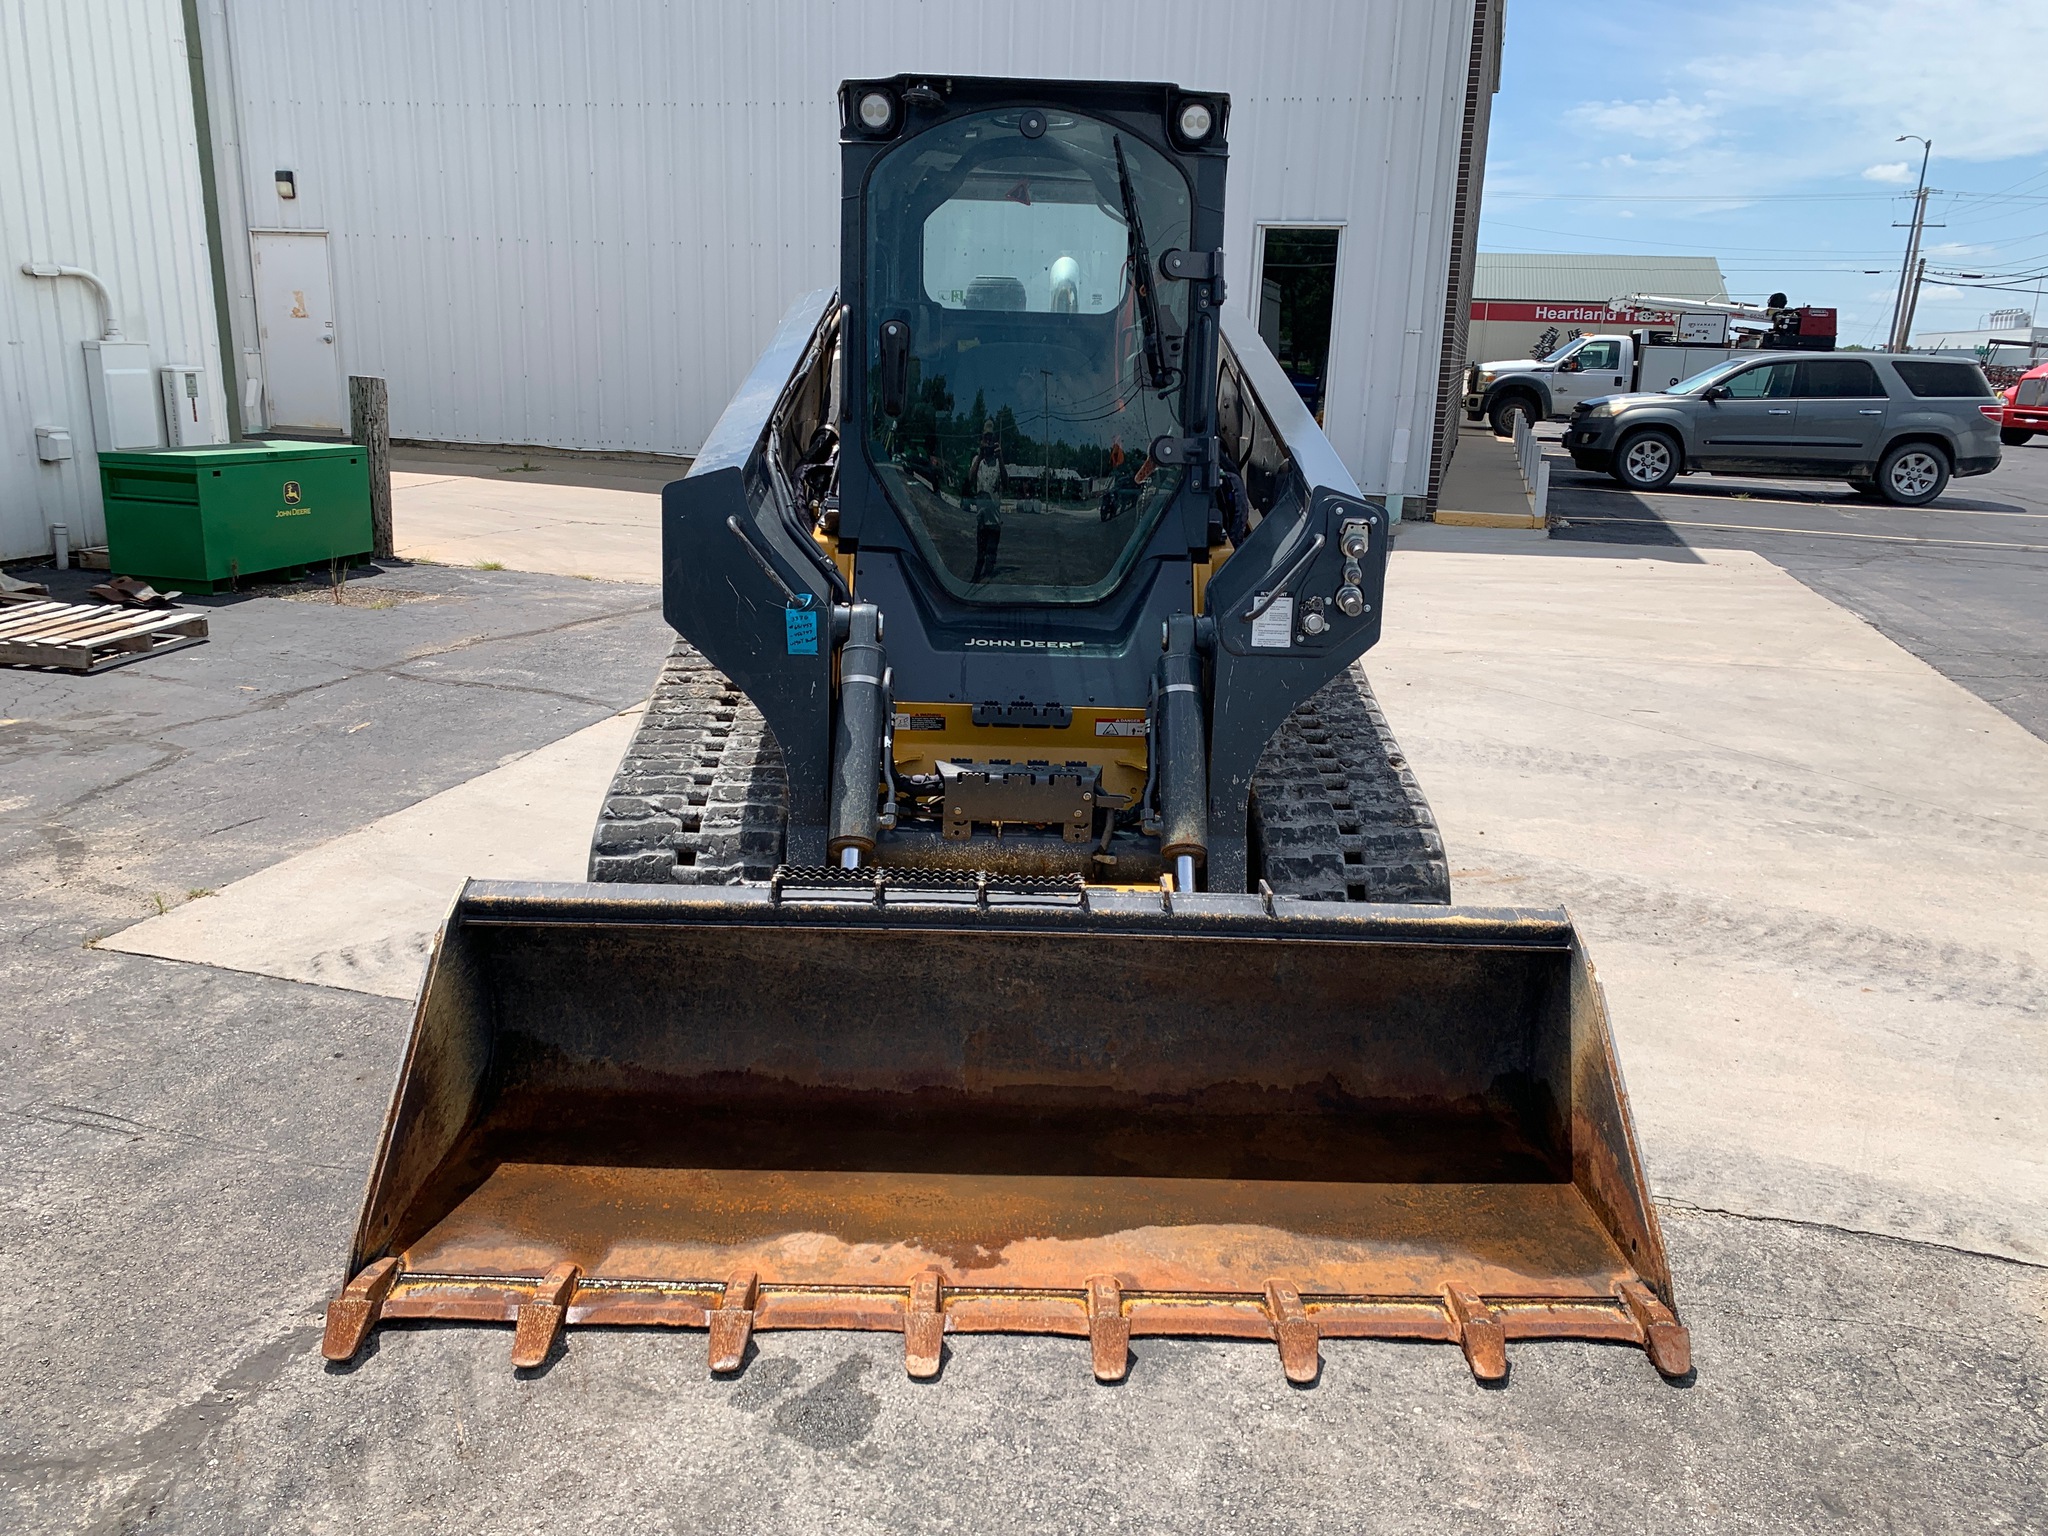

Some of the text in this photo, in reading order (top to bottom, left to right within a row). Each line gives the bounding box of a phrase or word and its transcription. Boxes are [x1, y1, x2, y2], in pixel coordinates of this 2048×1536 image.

[1535, 306, 1617, 321] Heartland
[275, 507, 312, 518] JOHN DEERE
[964, 638, 1016, 647] JOHN
